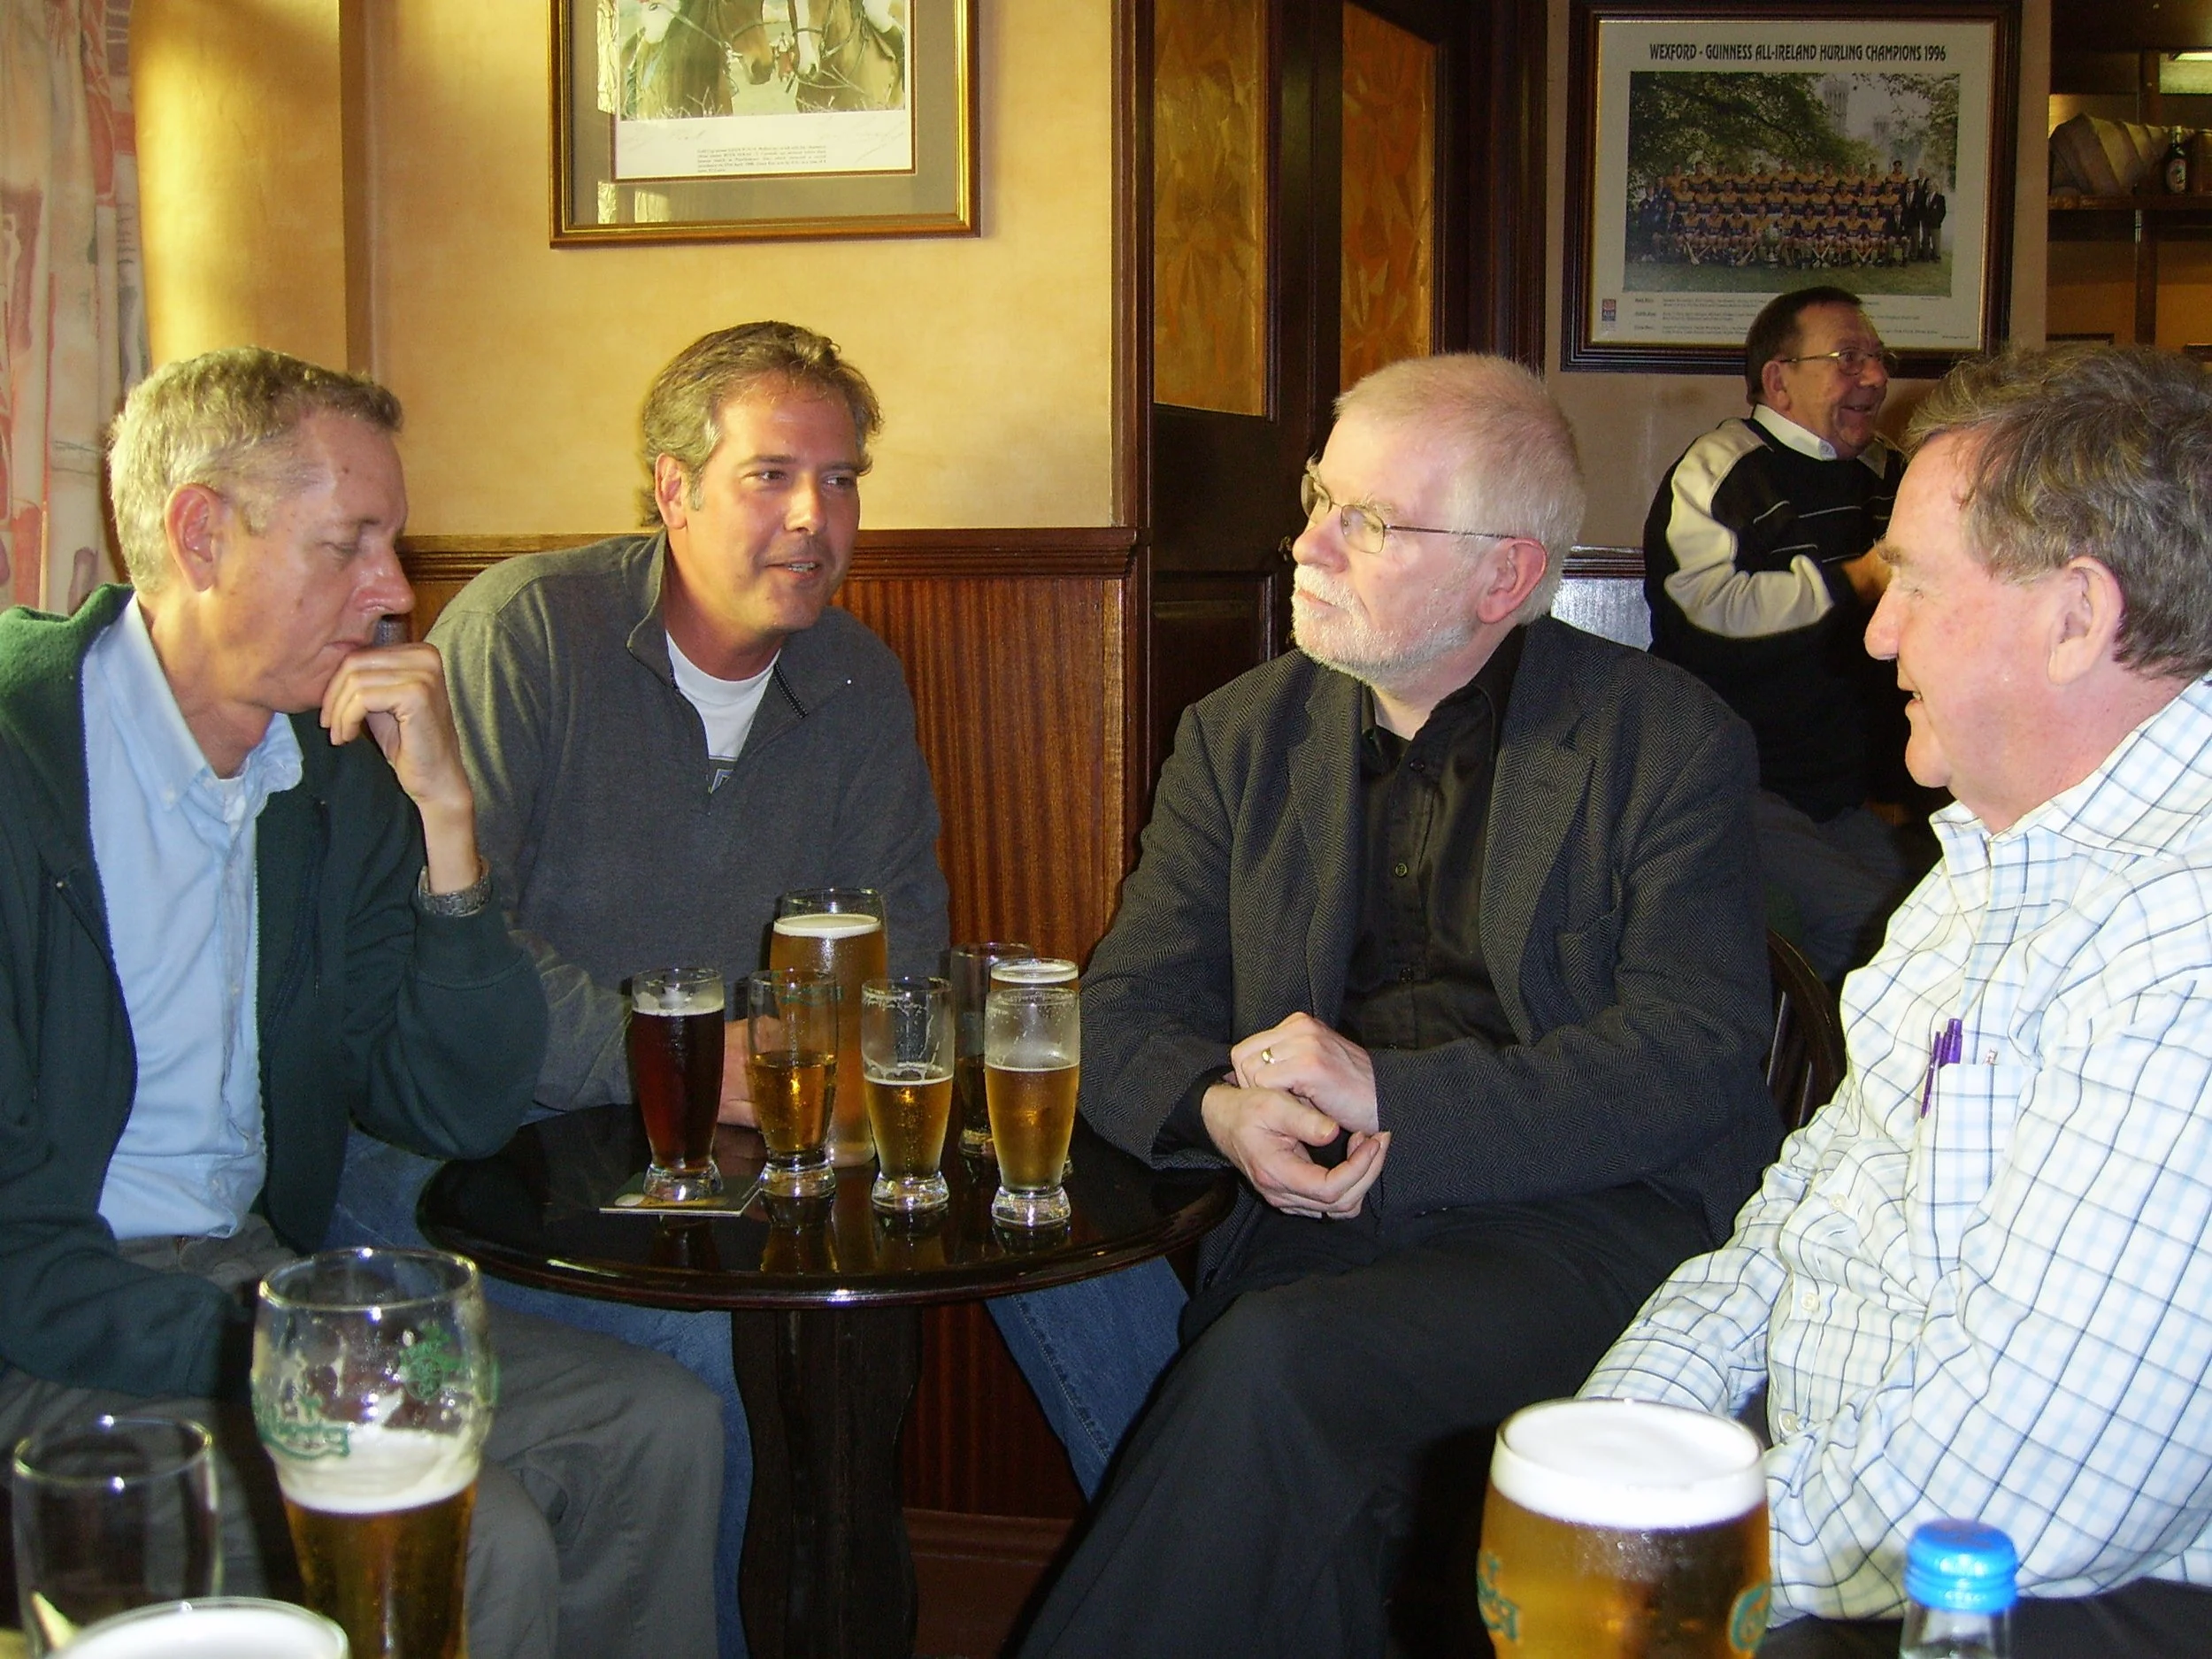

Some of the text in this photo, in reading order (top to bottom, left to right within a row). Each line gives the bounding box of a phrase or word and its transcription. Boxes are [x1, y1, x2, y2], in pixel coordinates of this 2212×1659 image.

[1649, 44, 1697, 61] WEXFORD
[1706, 44, 1753, 61] GUINNESS
[1755, 44, 1816, 62] ALL-IRELAND
[1819, 44, 1863, 62] HURLING
[1865, 44, 1922, 62] CHAMPIONS
[1924, 44, 1947, 62] 1996
